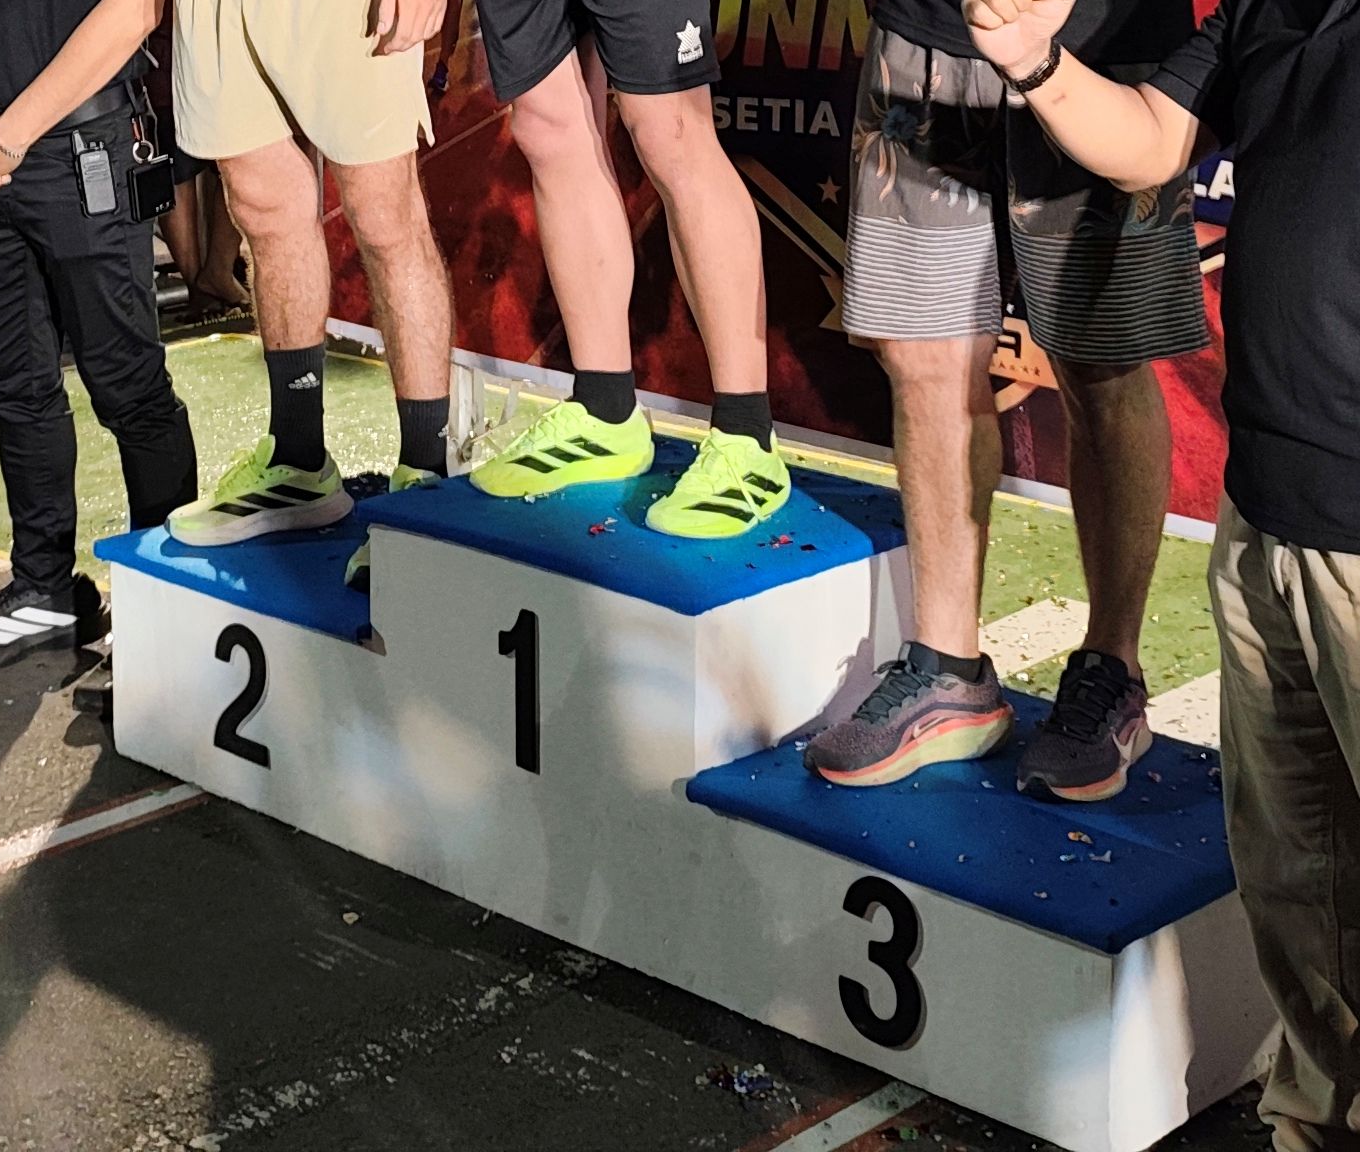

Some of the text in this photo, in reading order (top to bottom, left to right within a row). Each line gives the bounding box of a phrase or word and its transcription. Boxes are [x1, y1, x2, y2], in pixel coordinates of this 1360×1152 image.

[712, 97, 841, 138] SETIA
[213, 622, 272, 768] 2
[498, 608, 541, 774] 1
[838, 875, 924, 1049] 3
